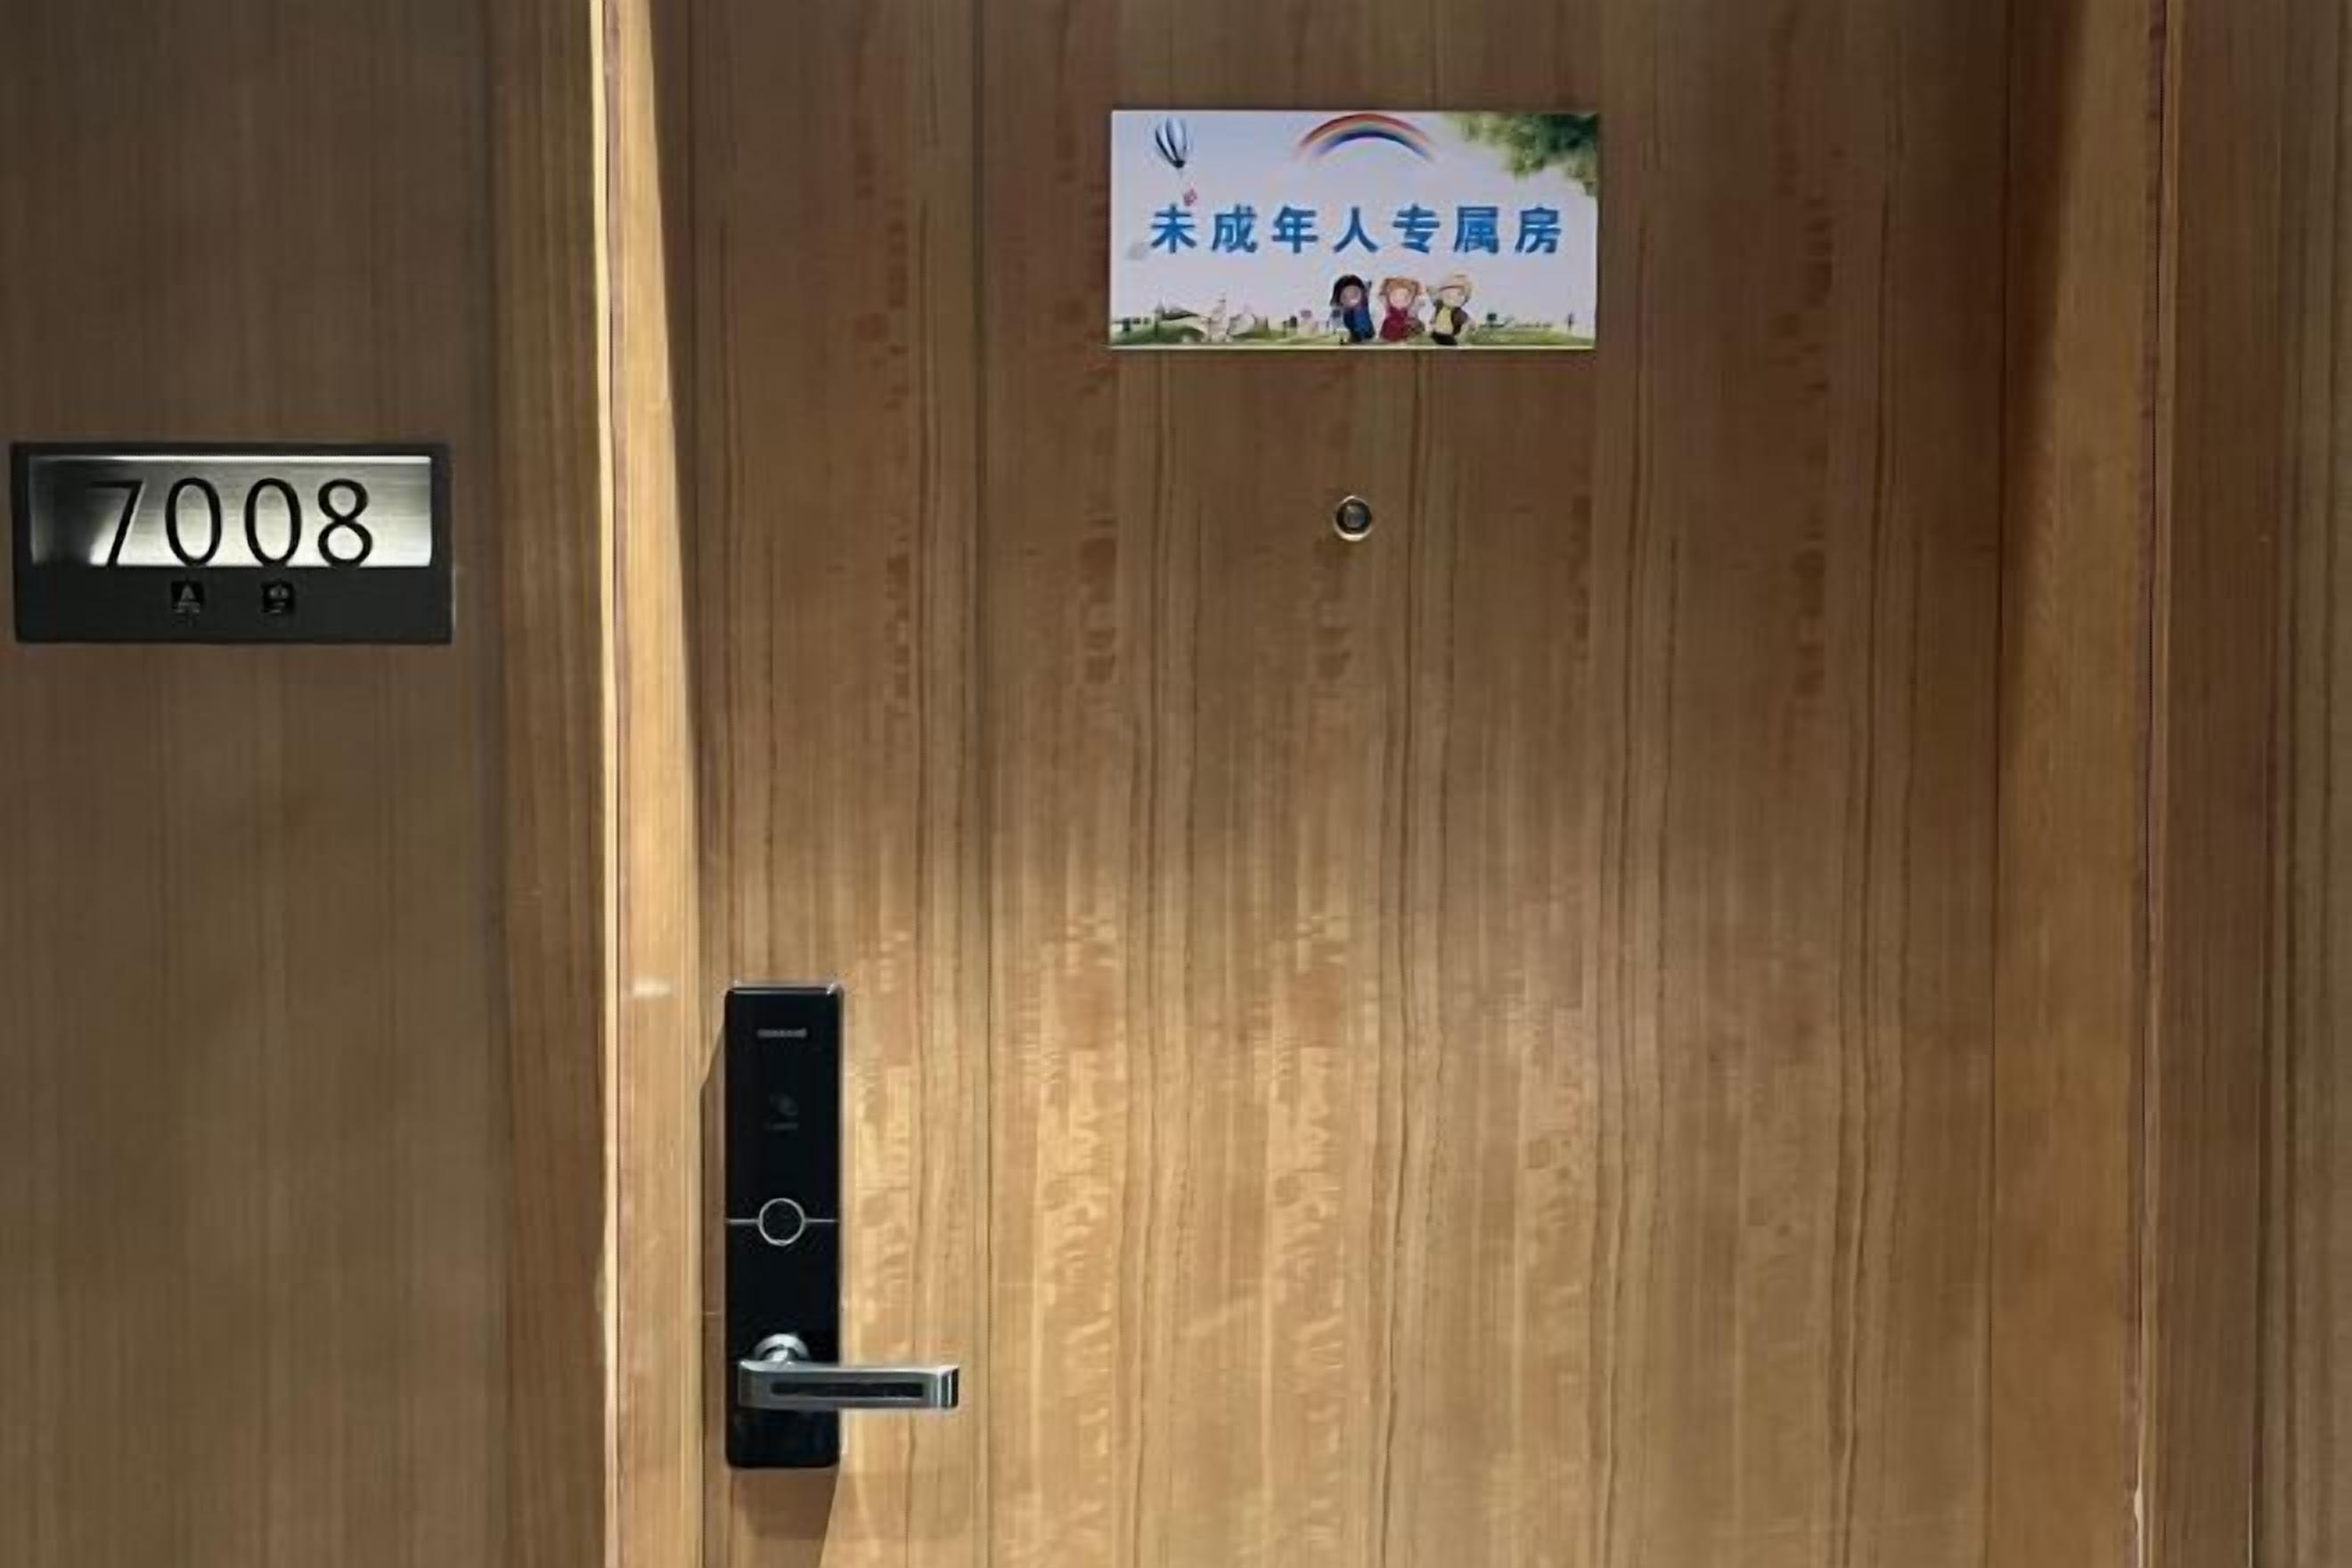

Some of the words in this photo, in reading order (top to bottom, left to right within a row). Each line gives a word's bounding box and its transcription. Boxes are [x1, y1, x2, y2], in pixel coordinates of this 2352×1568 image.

[1151, 204, 1563, 255] 未成年人专属房
[89, 478, 372, 567] 7008
